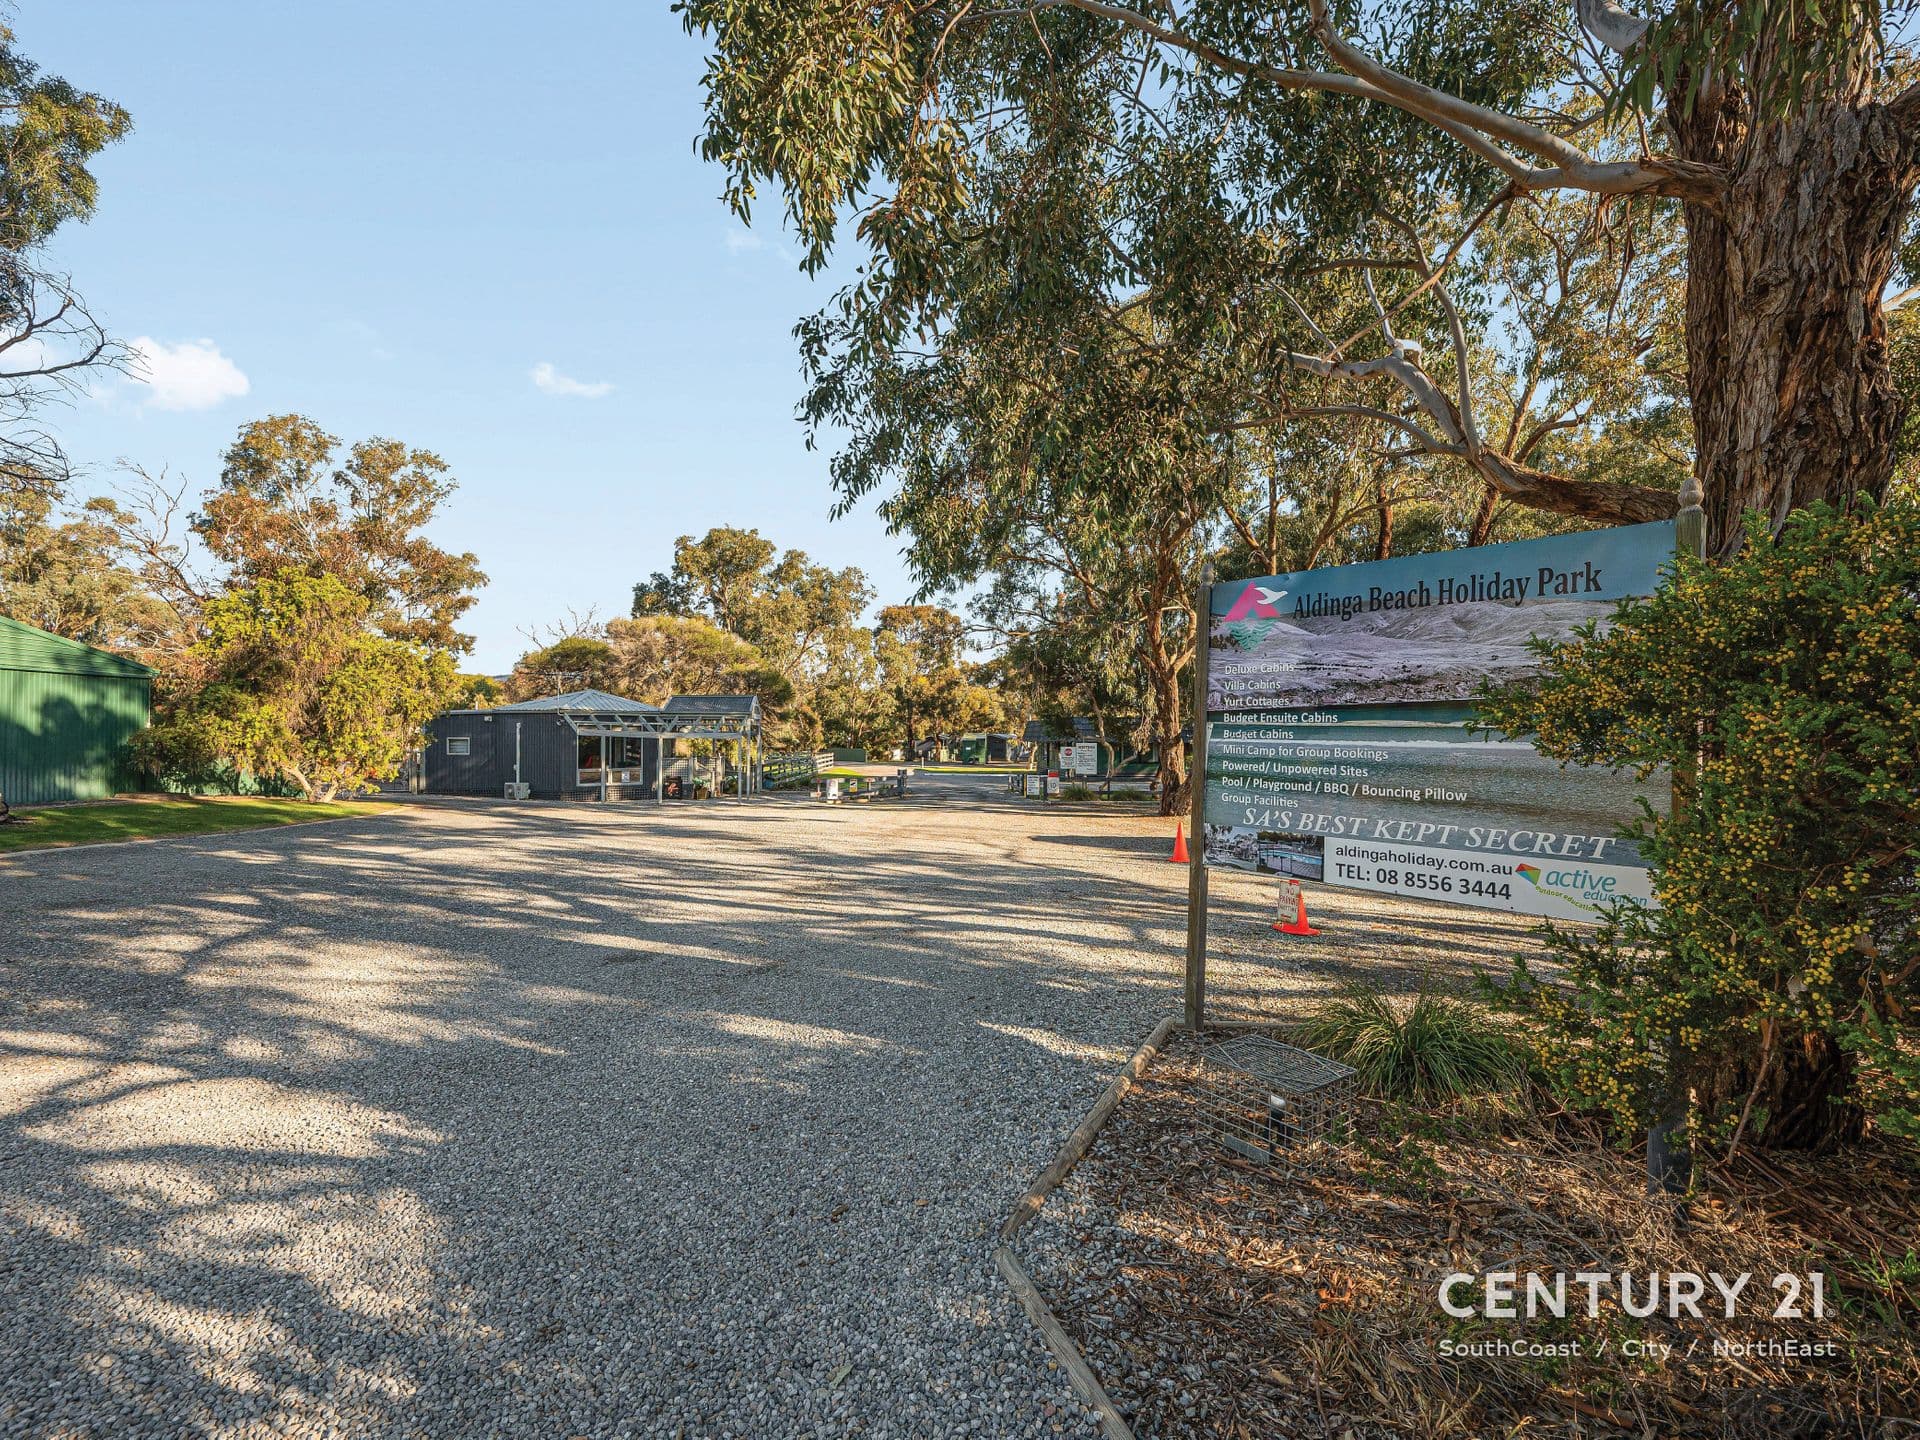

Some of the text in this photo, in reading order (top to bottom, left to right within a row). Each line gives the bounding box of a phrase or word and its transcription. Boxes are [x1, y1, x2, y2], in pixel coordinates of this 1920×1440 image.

[1293, 561, 1602, 621] Aldinga Beach Holiday Park
[1224, 662, 1295, 675] Deluxe Cabins
[1223, 679, 1281, 691] Villa Cabins
[1223, 697, 1290, 709] Yurt Cottages
[1223, 712, 1338, 724] Budget Ensuite Cabins
[1223, 729, 1294, 741] Budget Cabins
[1222, 744, 1389, 762] Mini Camp for Group Bookings
[1222, 760, 1369, 777] Powered/ Unpowered Sites
[1222, 776, 1243, 787] Pool
[1253, 778, 1312, 792] Playground
[1323, 782, 1349, 796] BBQ
[1361, 784, 1421, 801] Bouncing
[1425, 787, 1468, 801] Pillow
[1221, 792, 1299, 808] Group Facilities
[1243, 807, 1617, 859] SA'S BEST KEPT SECRET
[1335, 845, 1513, 876] aldingaholiday.com.au
[1335, 862, 1512, 900] TEL: 08 8556 3444
[1545, 869, 1617, 892] active
[1535, 885, 1563, 898] outdoor
[1583, 889, 1648, 907] educaon
